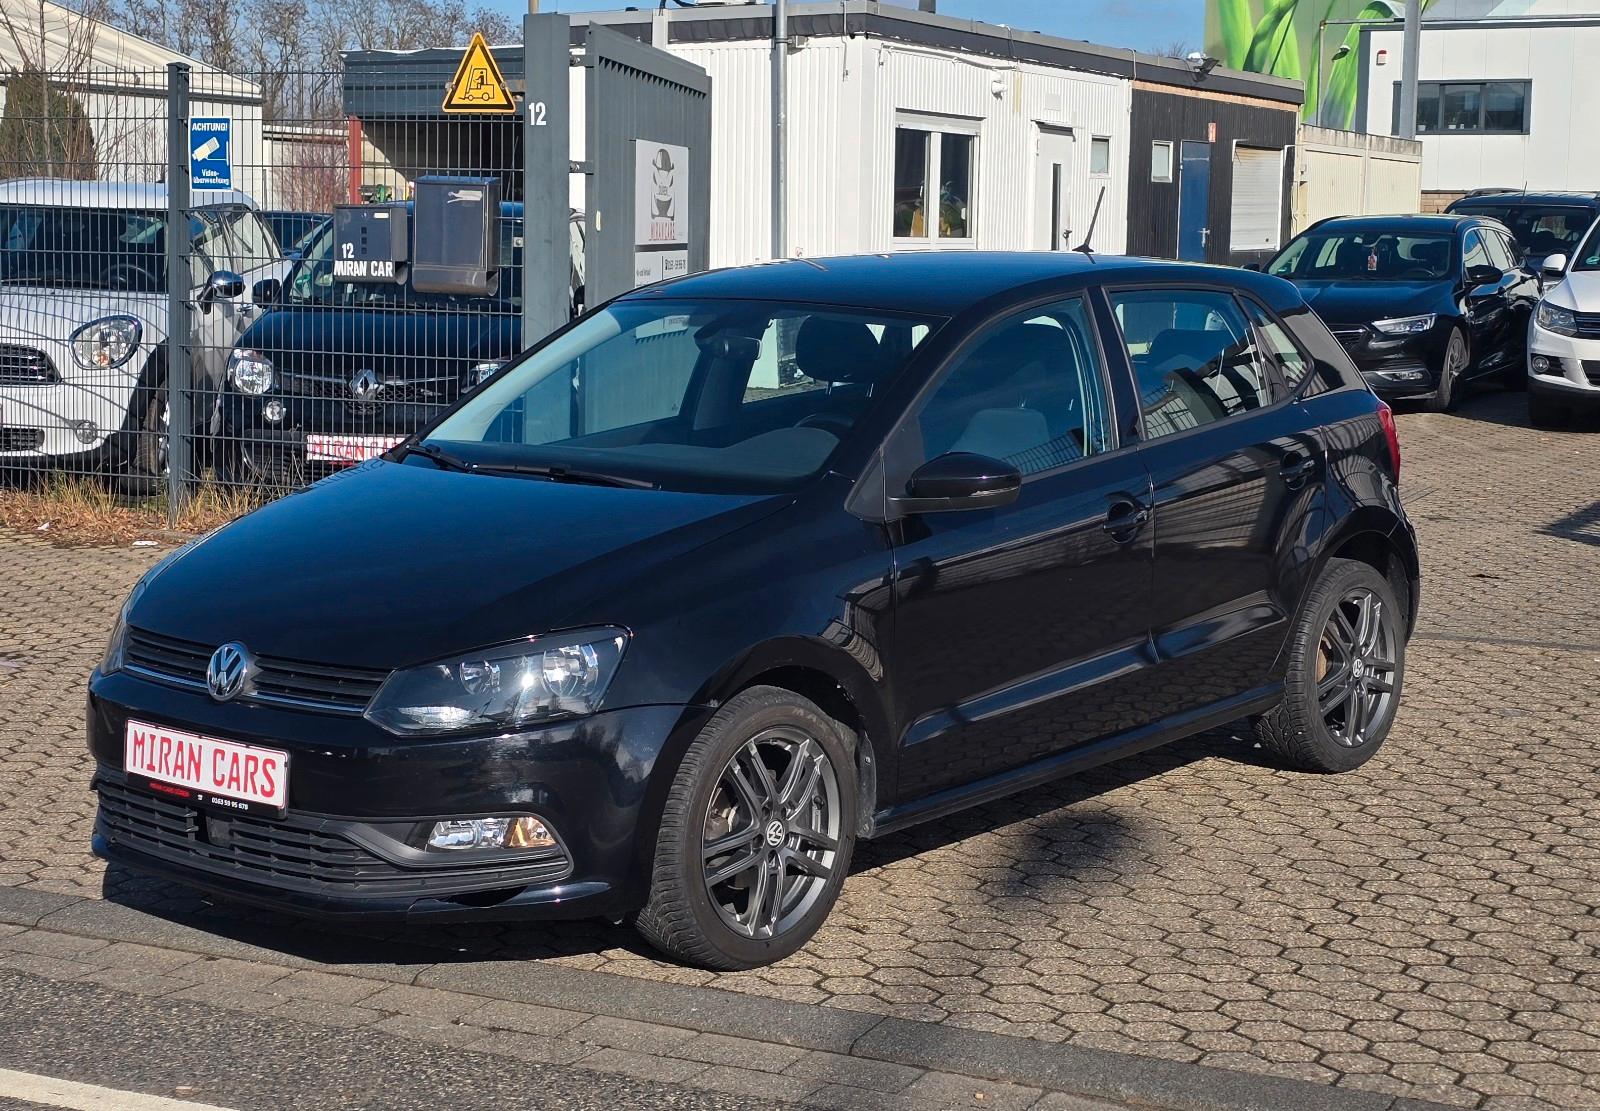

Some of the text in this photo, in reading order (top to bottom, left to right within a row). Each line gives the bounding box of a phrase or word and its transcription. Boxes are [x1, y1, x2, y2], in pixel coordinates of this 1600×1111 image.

[528, 102, 547, 126] 12
[192, 122, 228, 132] ACHTUNG!
[341, 243, 355, 259] 12
[334, 261, 393, 278] MIRAN CAR
[312, 440, 364, 459] MIRAN
[132, 729, 277, 798] MIRAN CARS
